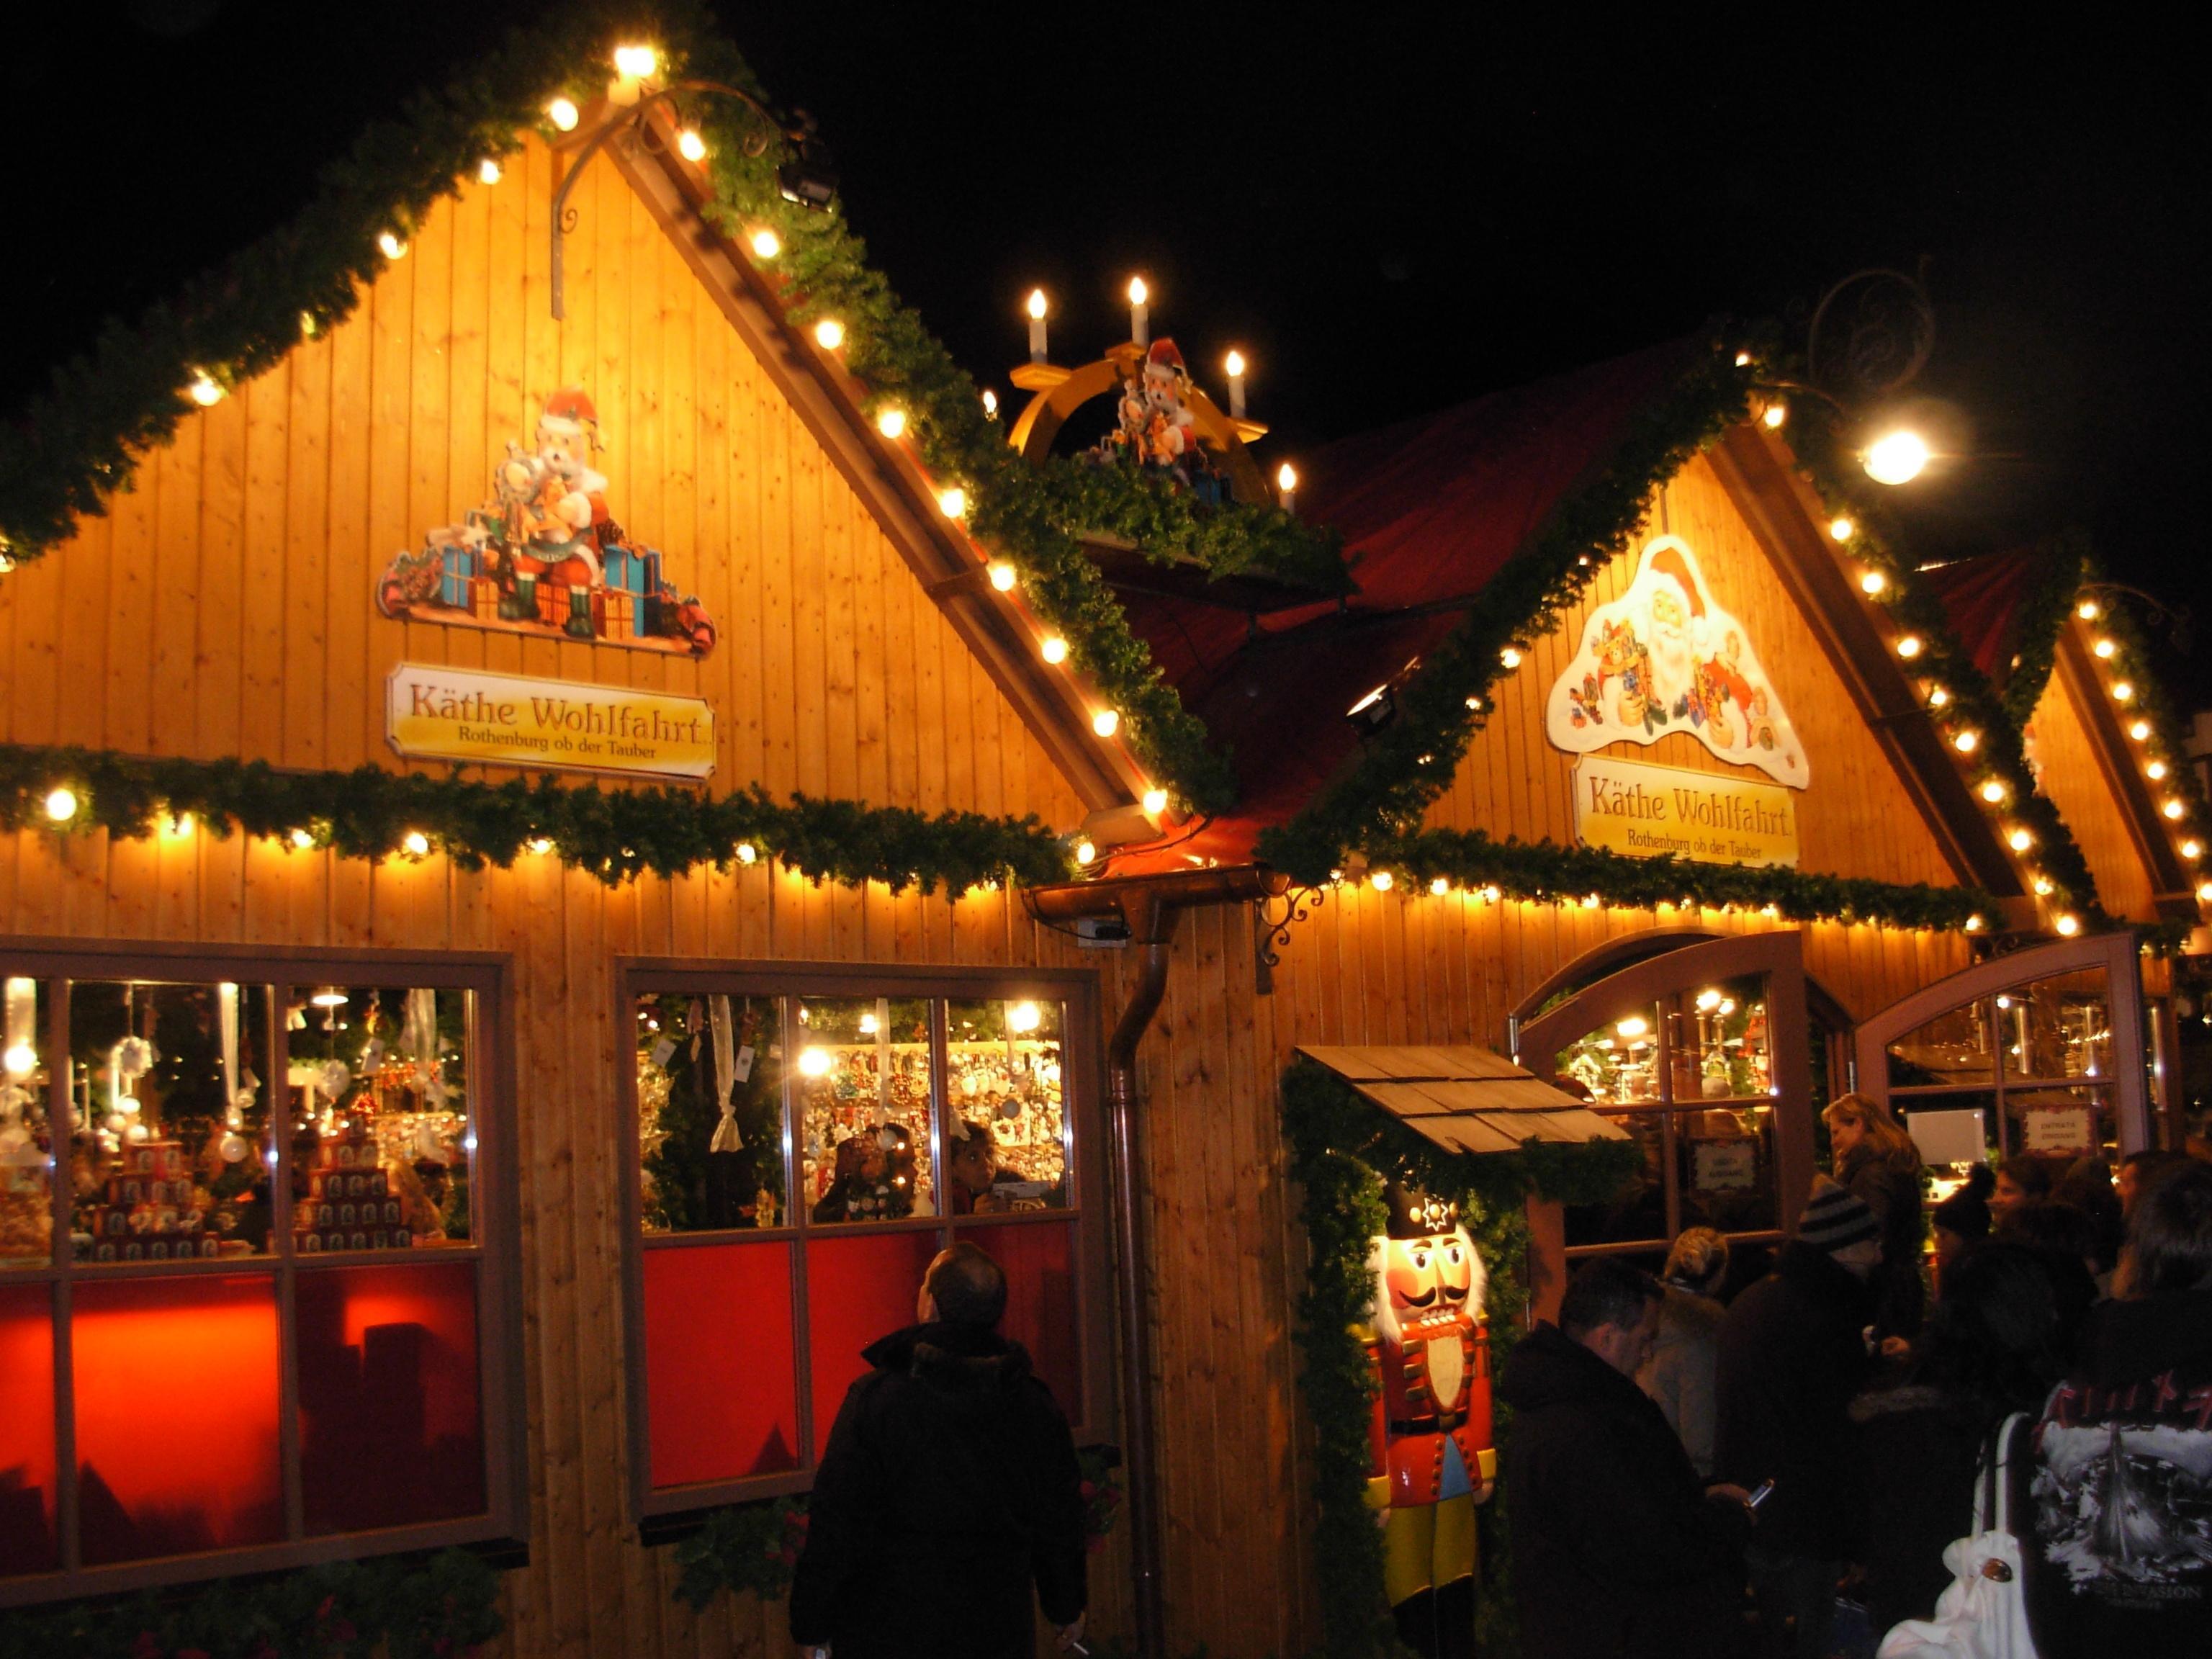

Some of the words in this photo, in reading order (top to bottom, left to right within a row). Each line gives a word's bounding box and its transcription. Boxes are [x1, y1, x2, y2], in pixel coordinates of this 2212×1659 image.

[410, 683, 516, 726] Käthe
[459, 726, 549, 751] Rothenburg
[554, 737, 574, 751] ob
[578, 738, 602, 755] der
[607, 742, 657, 759] Tauber
[1588, 775, 1666, 821] Käthe
[1627, 829, 1690, 855] Rothenburg
[1694, 837, 1707, 853] ob
[1709, 837, 1726, 855] der
[1727, 840, 1762, 859] Tauber
